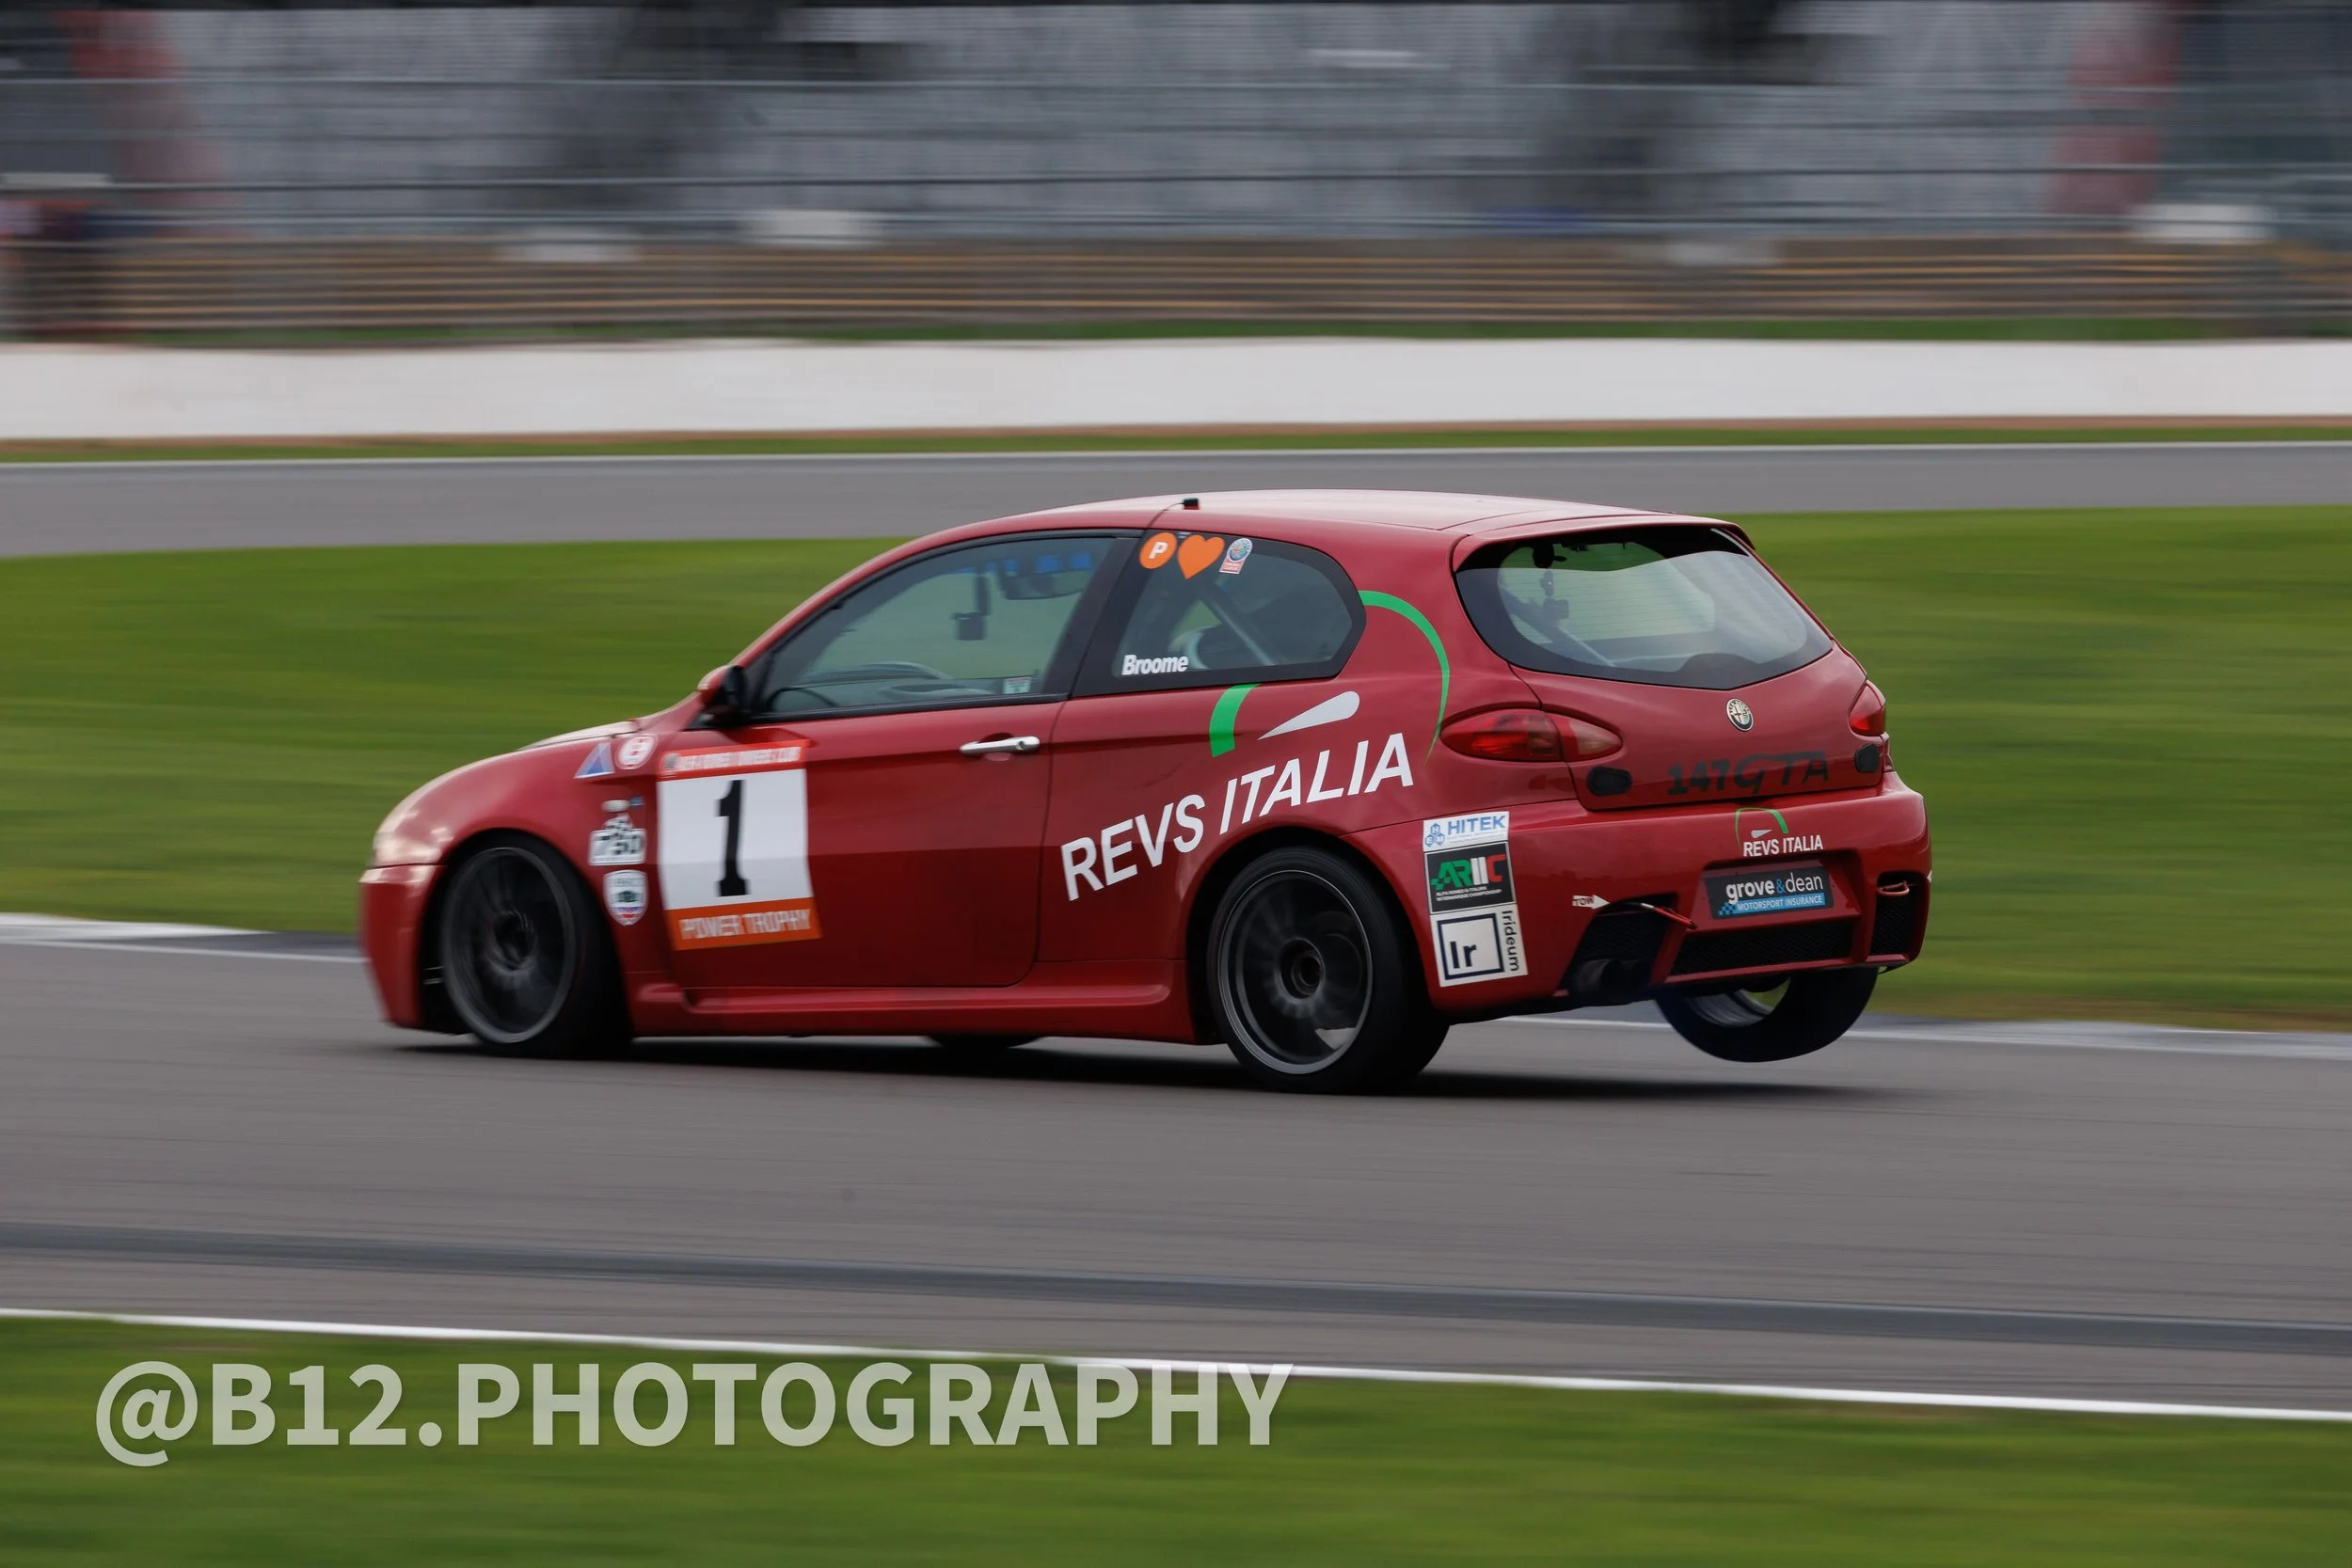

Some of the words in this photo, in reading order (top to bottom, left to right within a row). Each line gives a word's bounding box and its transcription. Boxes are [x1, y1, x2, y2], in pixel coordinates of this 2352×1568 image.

[1149, 541, 1168, 560] P
[1121, 654, 1189, 676] Broome
[1060, 794, 1206, 902] REVS
[1219, 732, 1414, 835] ITALIA
[1447, 815, 1506, 836] HITEK
[715, 779, 750, 897] 1
[1743, 839, 1780, 857] REVS
[1783, 834, 1823, 854] ITALIA
[1737, 898, 1784, 911] MOTORSPORT
[1785, 895, 1823, 907] INSURANCE
[678, 914, 743, 940] POWER
[743, 909, 811, 934] TROPHY
[1502, 910, 1519, 972] Irideum
[1450, 941, 1477, 970] Ir
